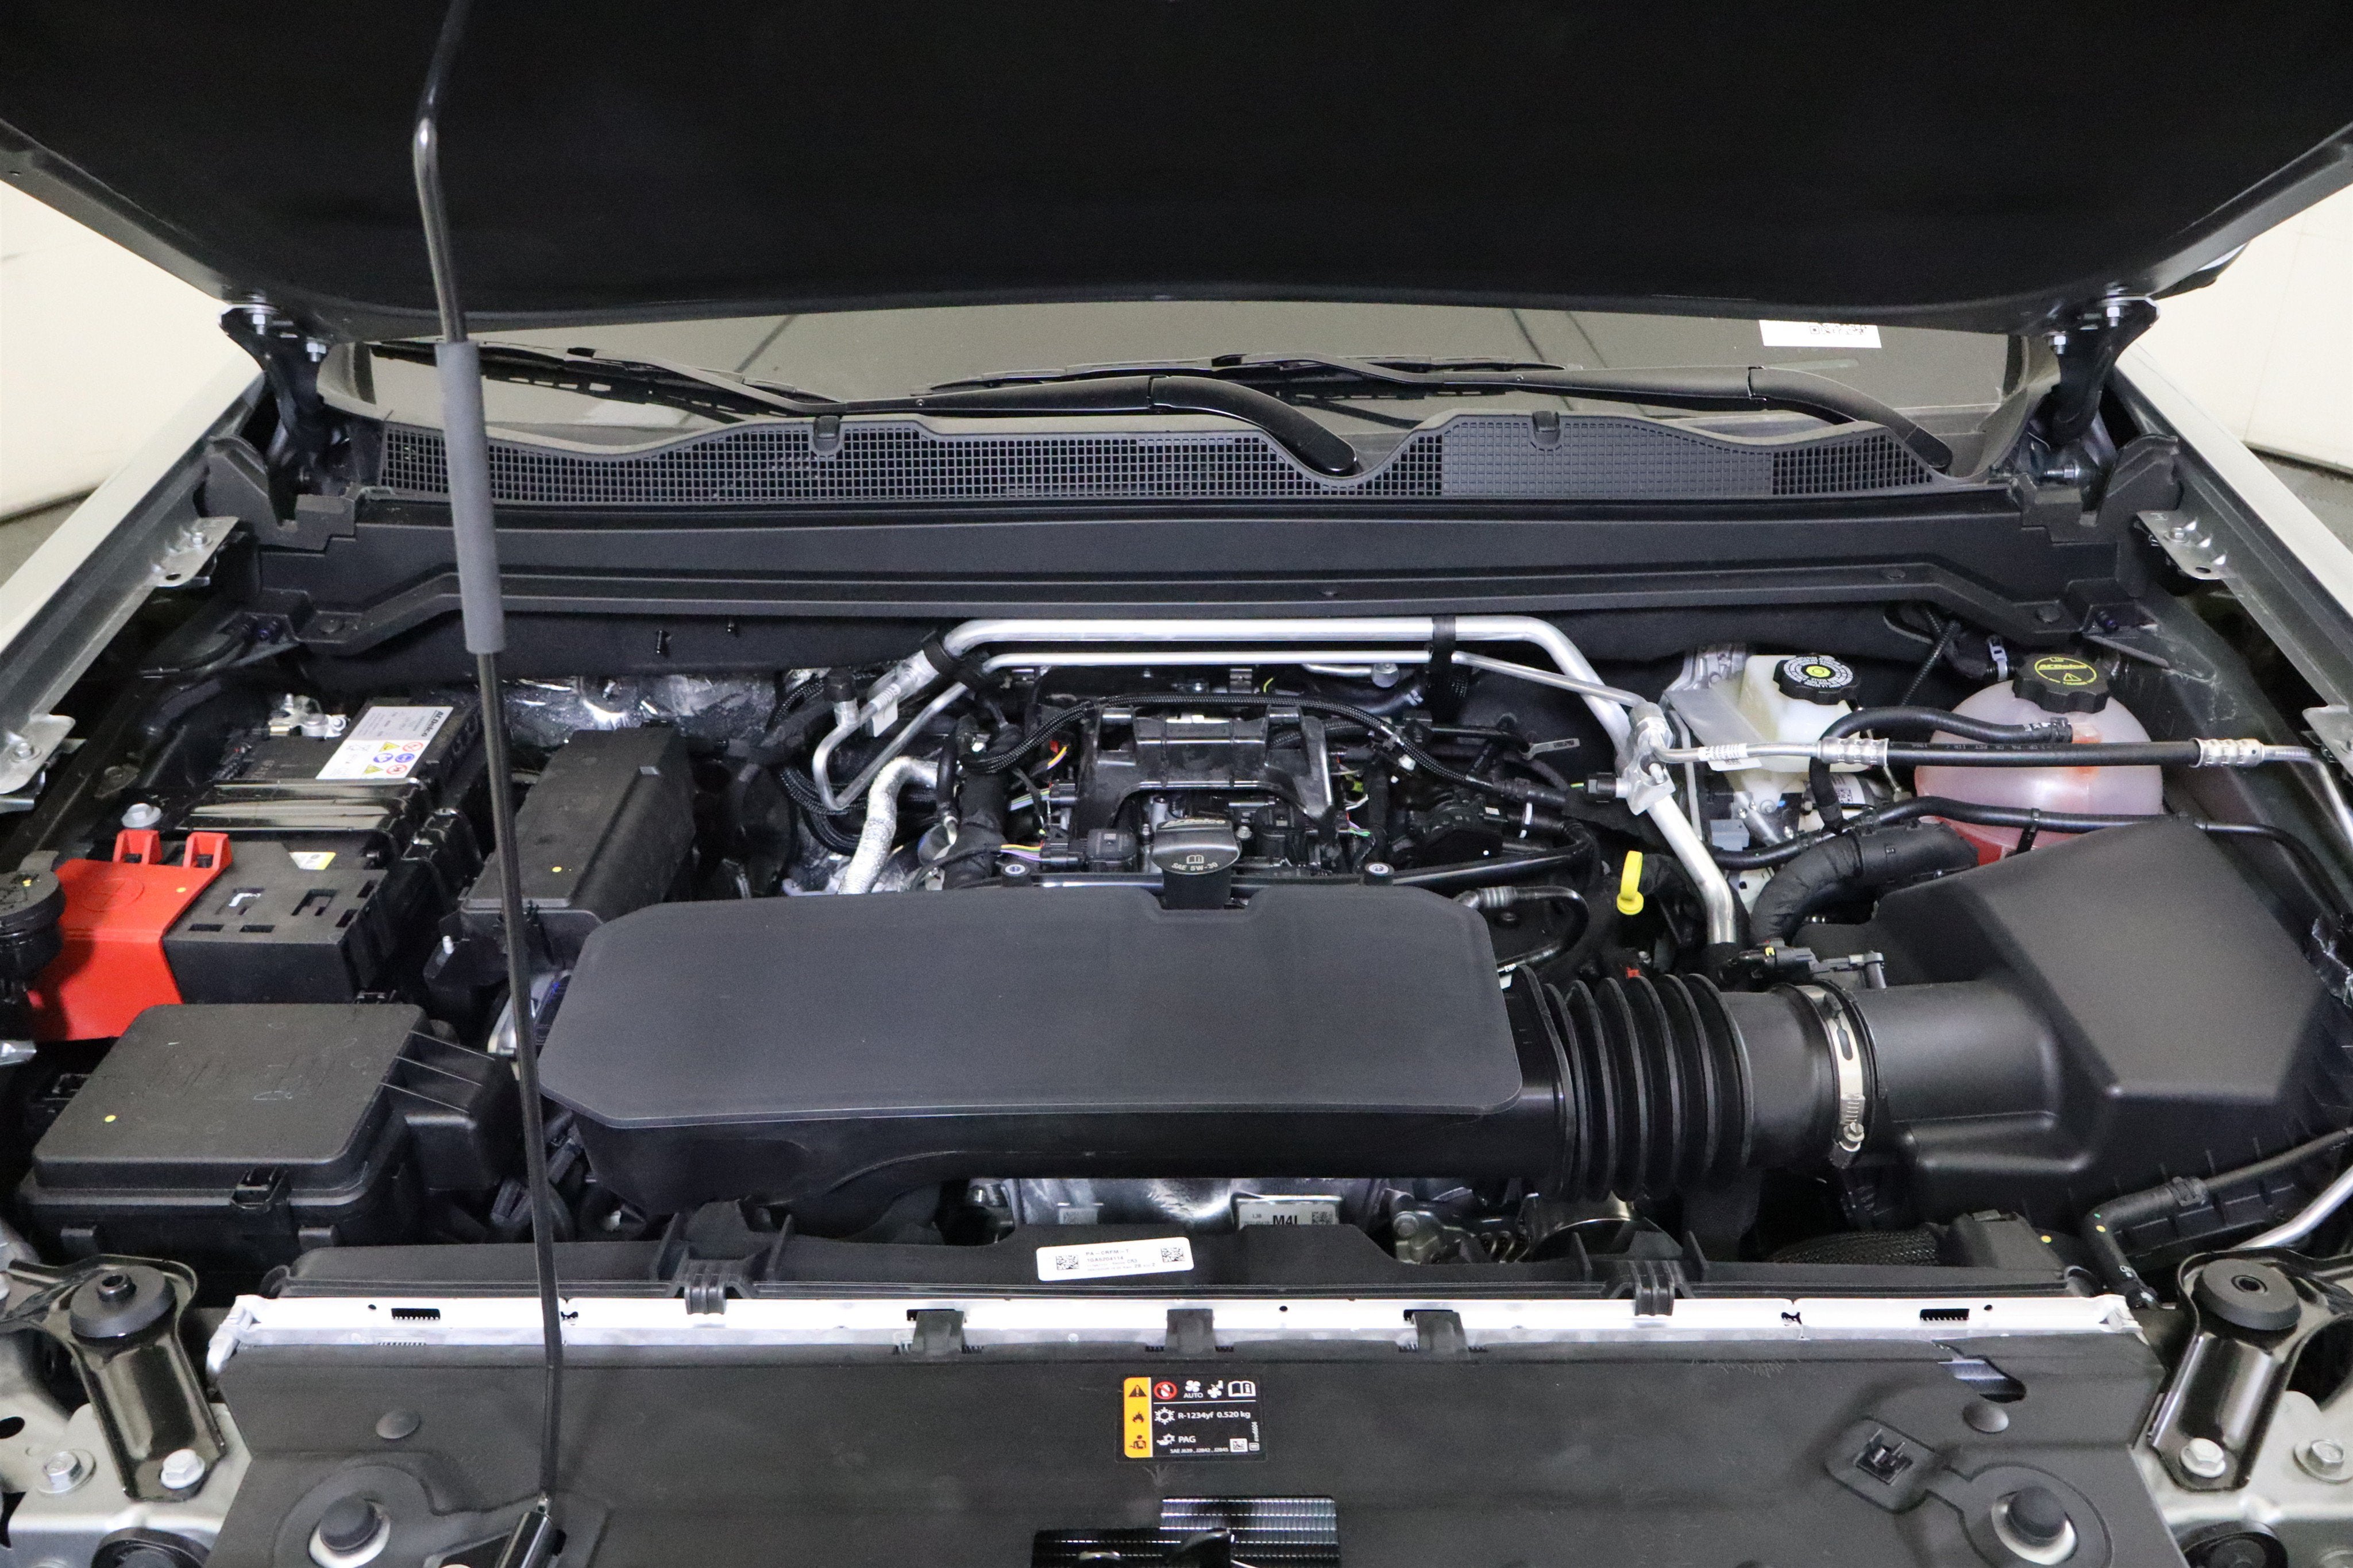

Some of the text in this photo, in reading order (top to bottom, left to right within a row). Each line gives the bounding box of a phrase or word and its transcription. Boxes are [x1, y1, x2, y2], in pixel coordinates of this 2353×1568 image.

[421, 710, 444, 737] ACDelco
[1171, 862, 1218, 871] SAE 5W-30
[1178, 1411, 1214, 1420] R-1234yf
[1240, 1411, 1251, 1419] kg
